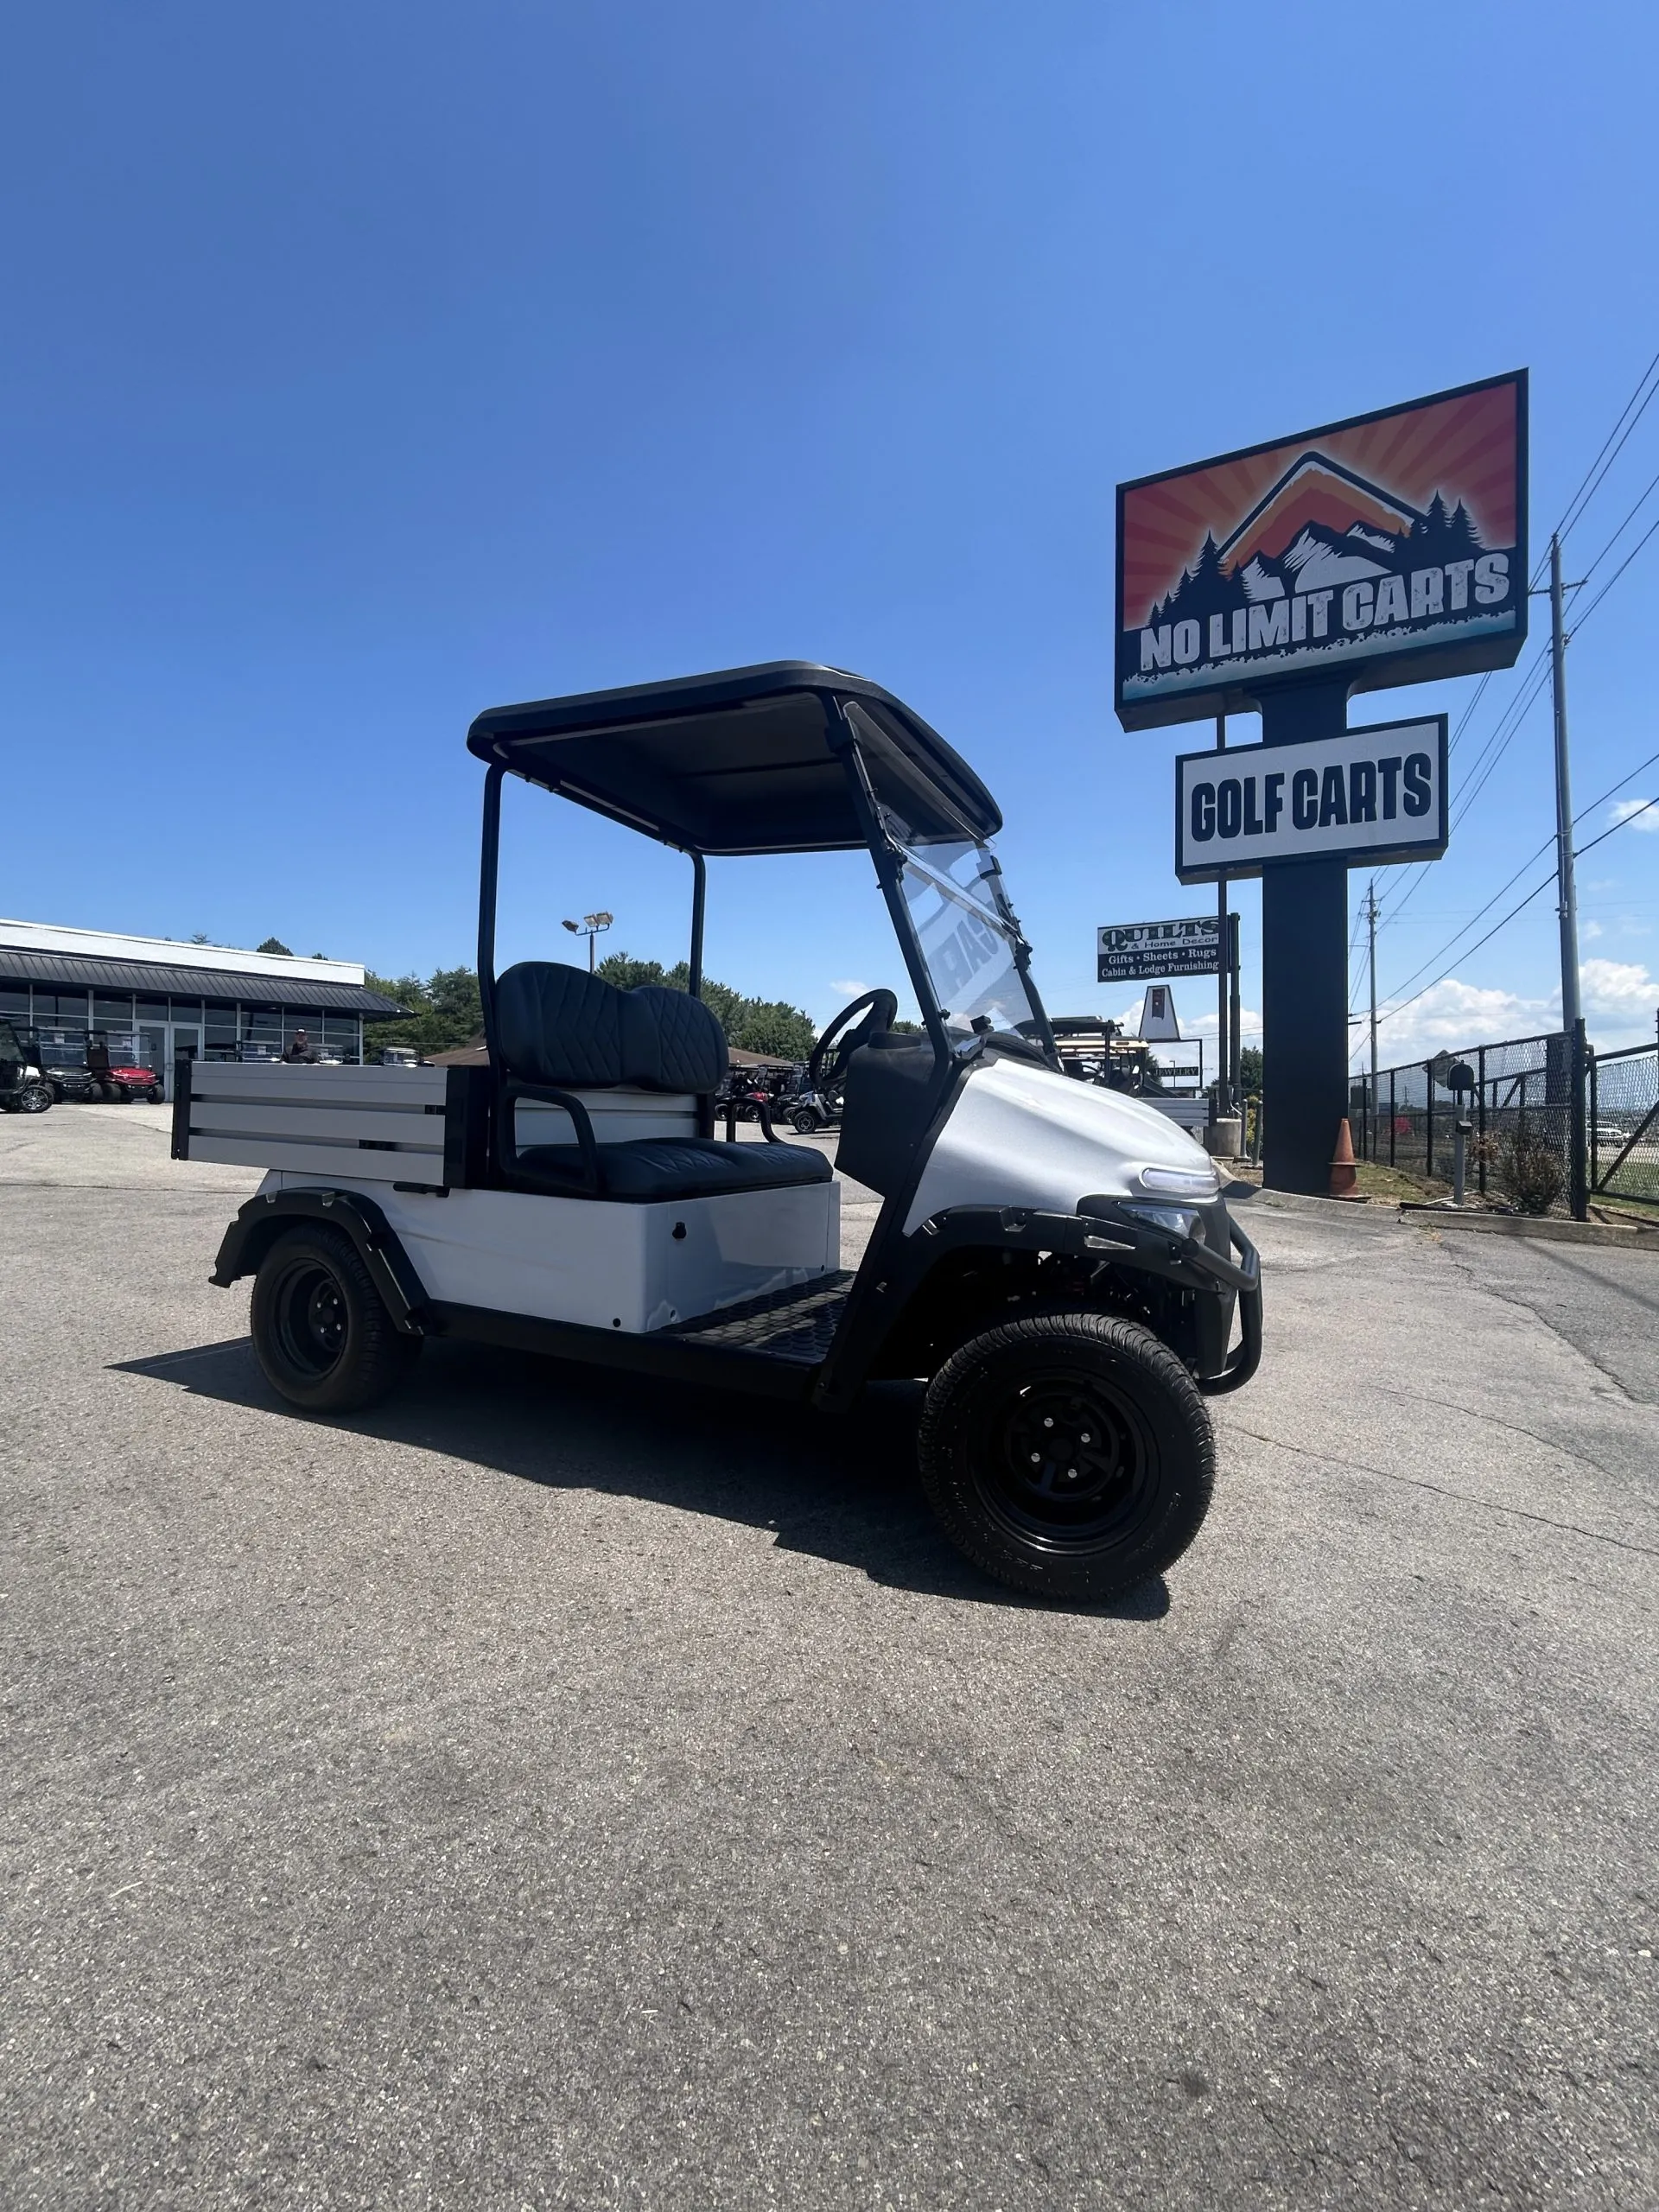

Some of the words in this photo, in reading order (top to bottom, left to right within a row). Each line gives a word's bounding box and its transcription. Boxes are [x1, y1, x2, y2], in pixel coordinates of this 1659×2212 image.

[1140, 619, 1200, 671] NO
[1209, 589, 1334, 658] LIMIT
[1342, 553, 1510, 631] CARTS
[1191, 772, 1285, 842] GOLF
[1292, 753, 1432, 830] CARTS
[1102, 919, 1218, 952] QUILTS
[1144, 940, 1176, 949] Home
[1182, 937, 1218, 945] Decor
[1108, 955, 1134, 964] Gifts
[1142, 951, 1179, 962] Sheets
[1188, 949, 1217, 958] Rugs
[1101, 967, 1126, 977] Cabin
[1128, 966, 1137, 976] &
[1139, 964, 1166, 975] Lodge
[1154, 1067, 1198, 1076] JEWELRY
